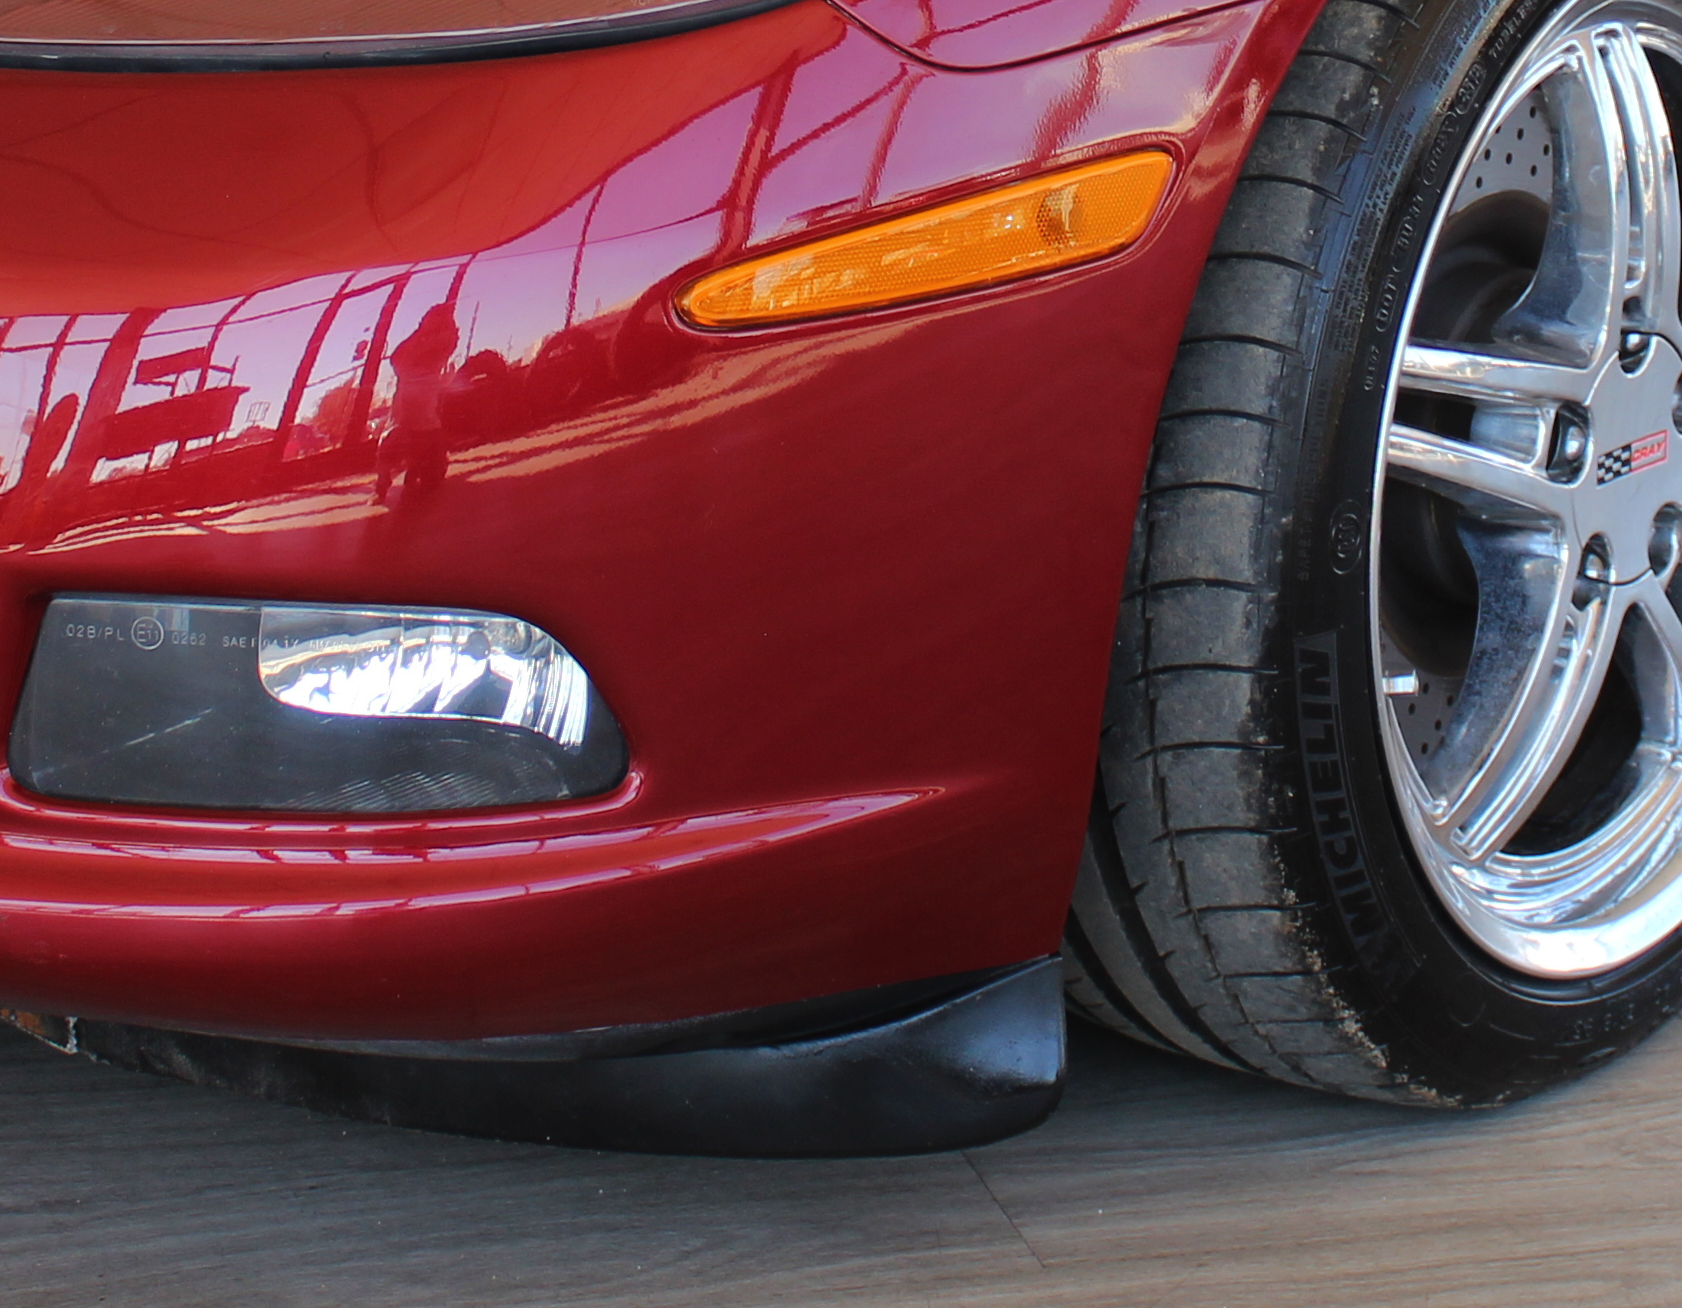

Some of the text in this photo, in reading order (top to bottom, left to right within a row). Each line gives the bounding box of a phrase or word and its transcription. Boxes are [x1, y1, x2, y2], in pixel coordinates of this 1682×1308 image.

[1376, 275, 1398, 329] DOT
[171, 632, 207, 646] 0262
[222, 636, 247, 648] SAE
[1297, 646, 1382, 946] MICHELIN
